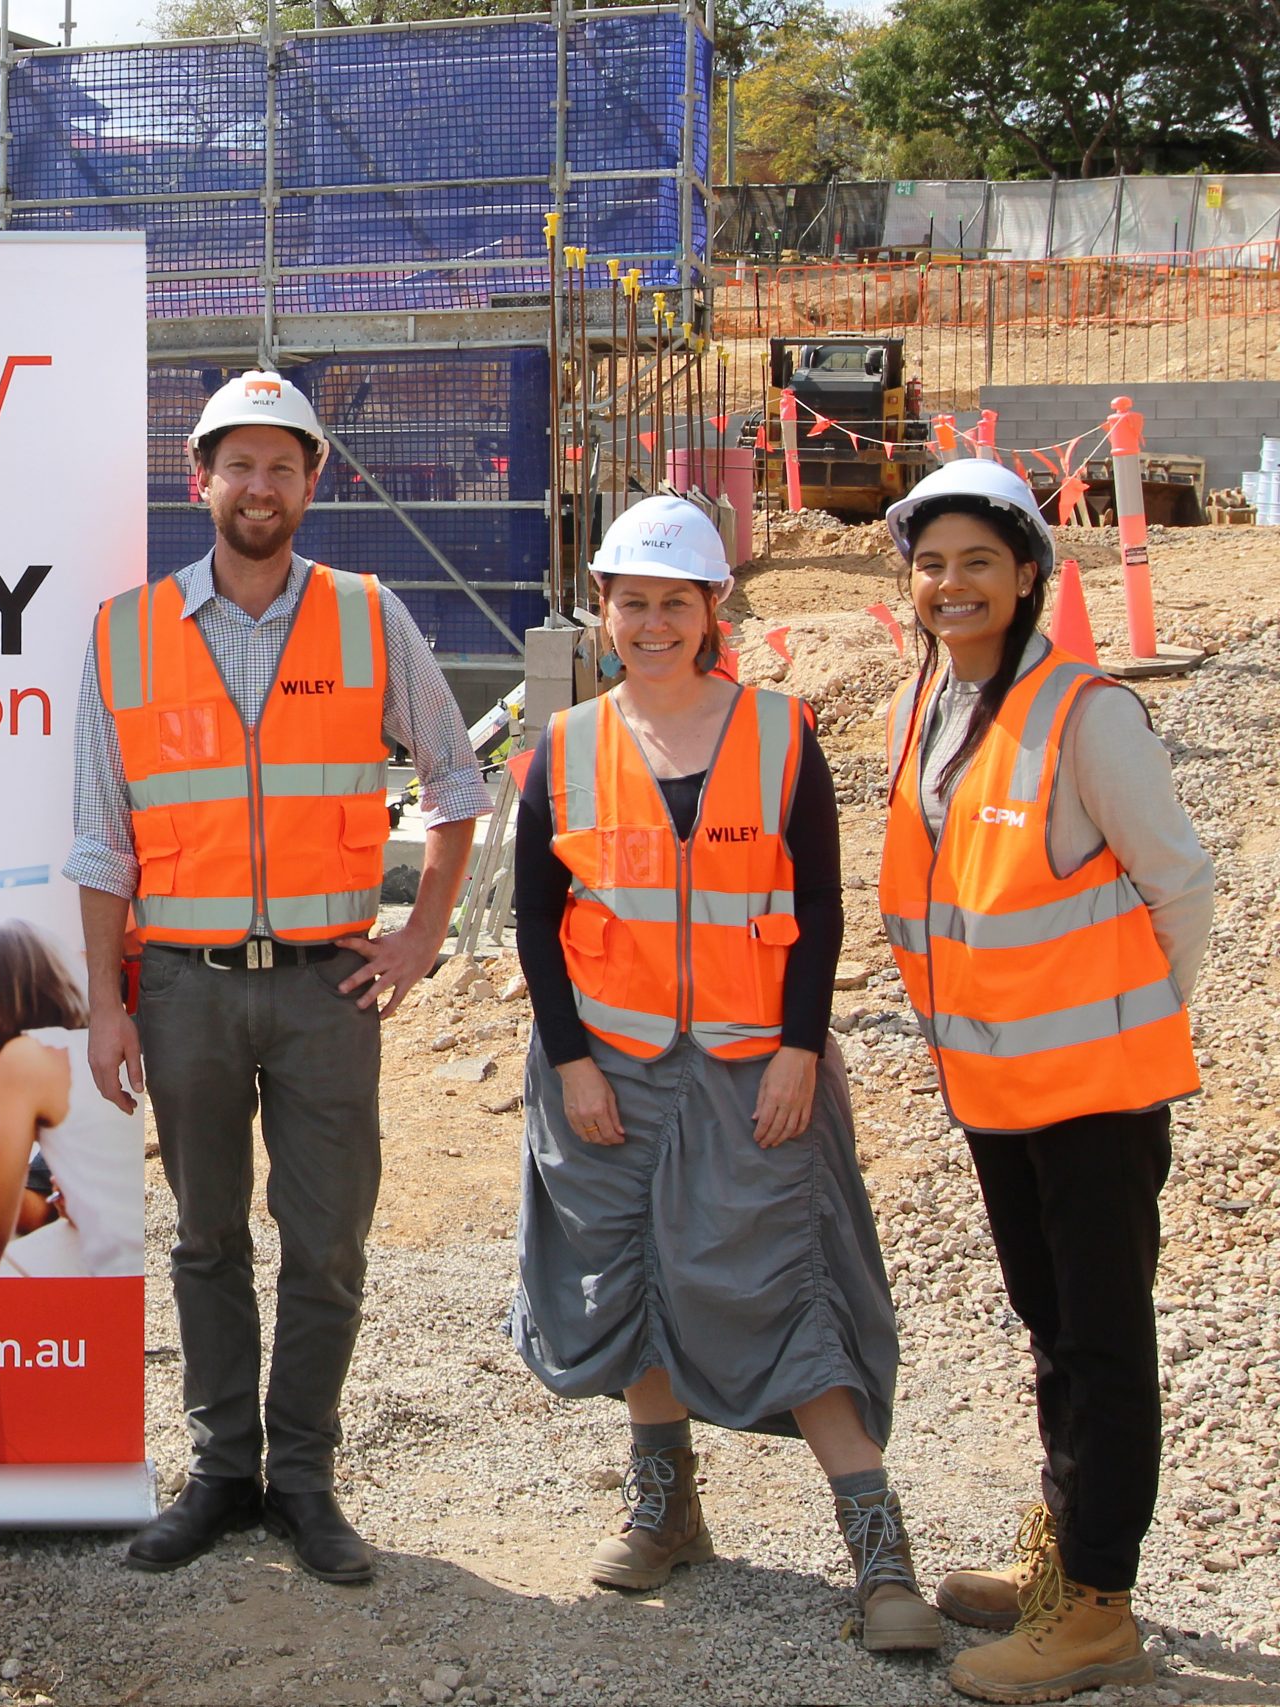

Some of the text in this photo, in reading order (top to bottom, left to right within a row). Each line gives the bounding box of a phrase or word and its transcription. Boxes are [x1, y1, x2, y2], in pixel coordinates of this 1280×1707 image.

[641, 540, 672, 549] WILEY
[280, 680, 335, 695] WILEY
[981, 805, 1025, 828] CPM
[705, 826, 759, 842] WILEY
